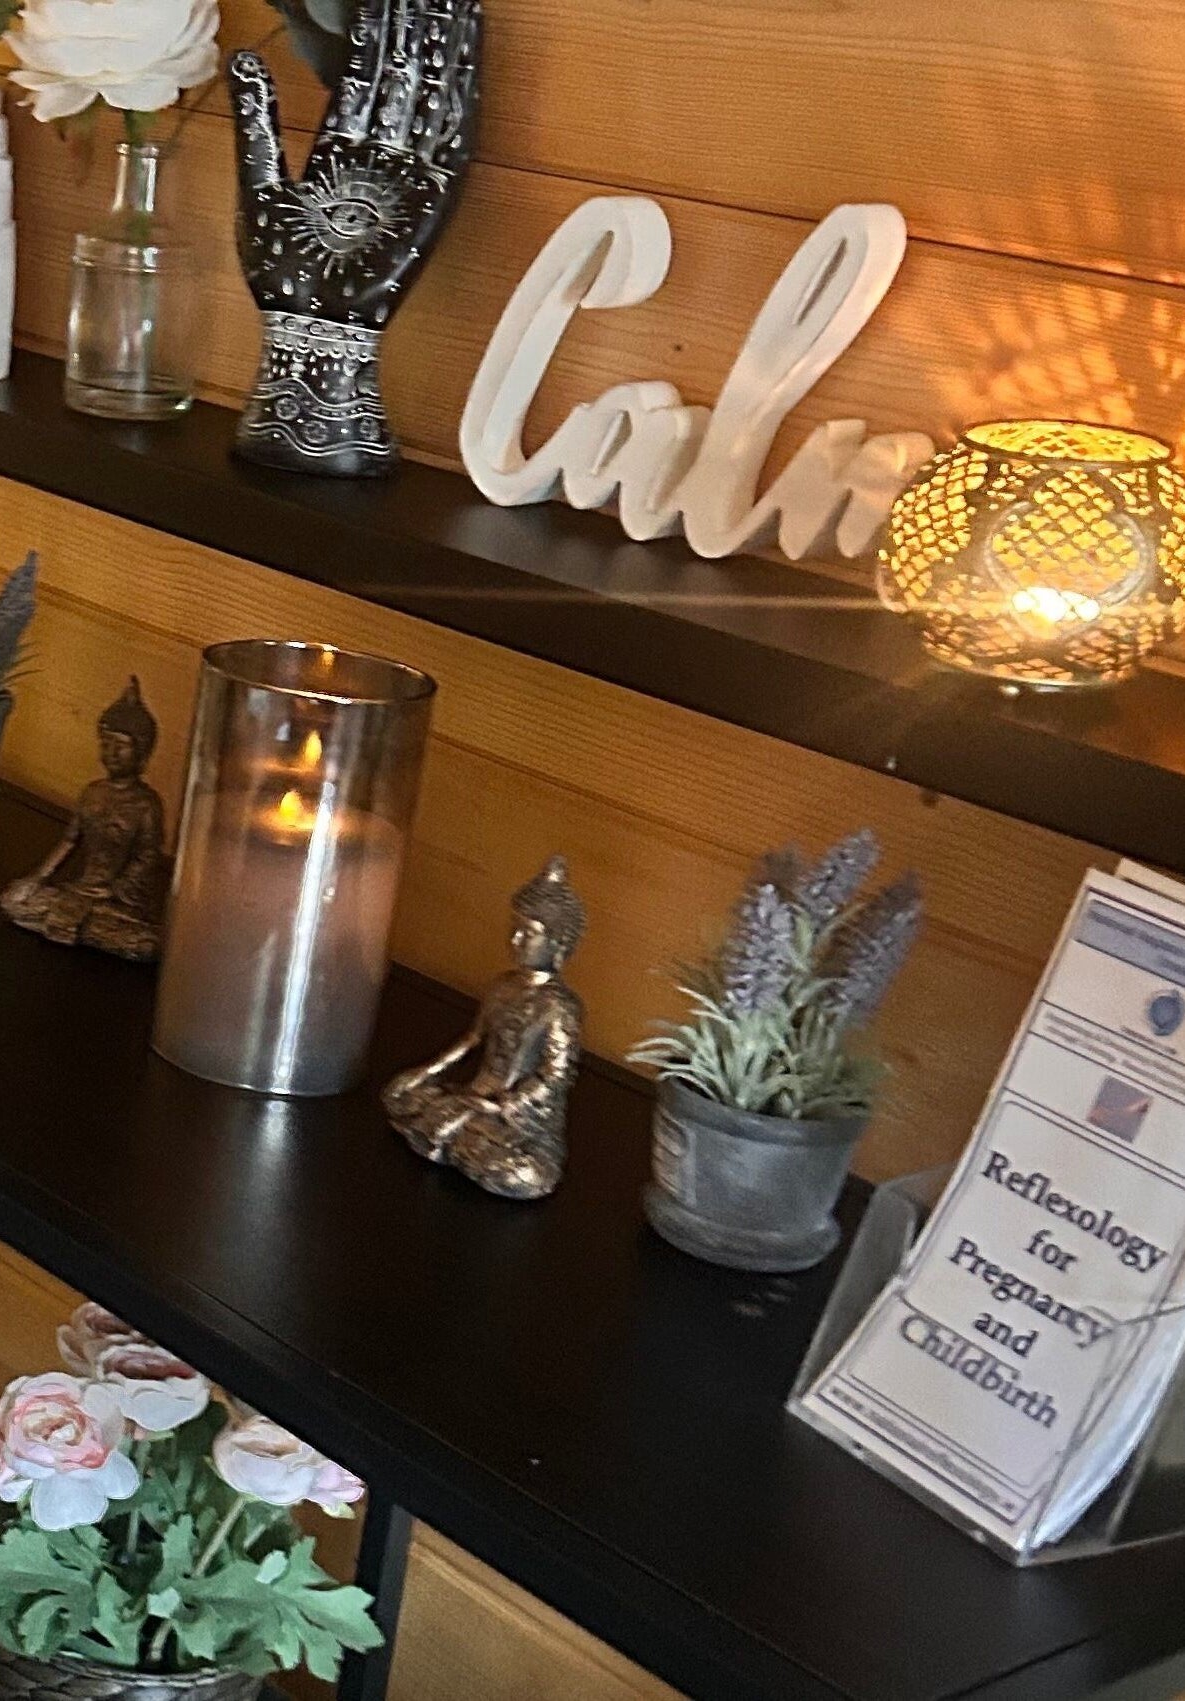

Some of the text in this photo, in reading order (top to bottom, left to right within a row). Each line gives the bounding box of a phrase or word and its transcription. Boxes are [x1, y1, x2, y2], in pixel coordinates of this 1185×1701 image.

[981, 1150, 1169, 1273] Reflexology
[1025, 1229, 1079, 1273] for
[947, 1236, 1113, 1349] Pregnancy
[973, 1312, 1039, 1359] and
[900, 1314, 1058, 1429] Childbirth
